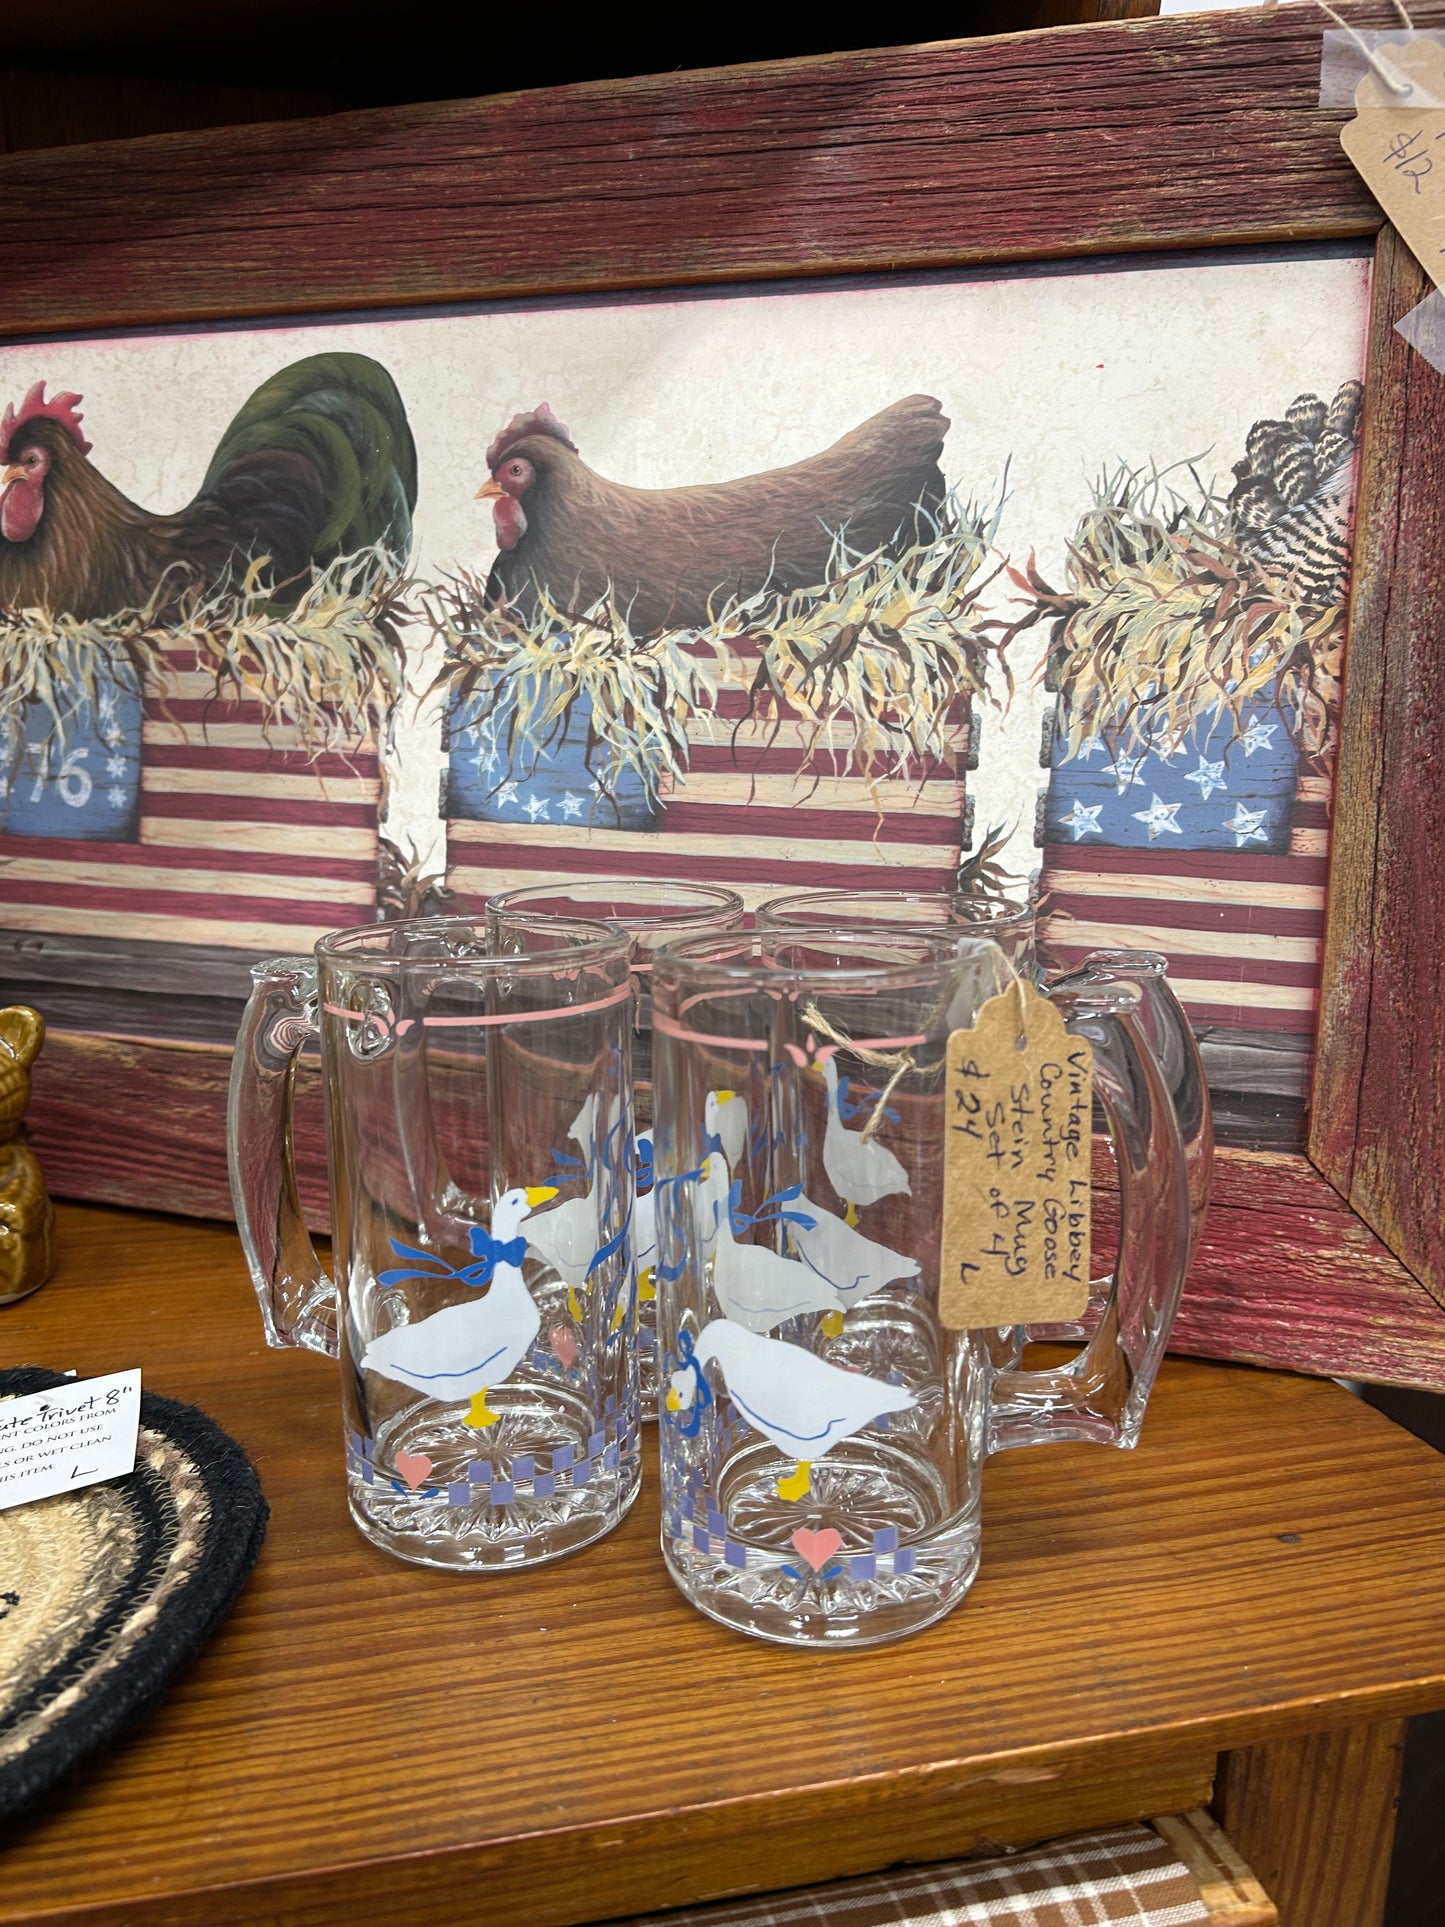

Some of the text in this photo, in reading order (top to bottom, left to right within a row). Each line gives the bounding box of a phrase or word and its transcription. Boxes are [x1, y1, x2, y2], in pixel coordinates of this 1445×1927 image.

[1383, 130, 1433, 194] $12
[25, 742, 93, 808] 76
[980, 1102, 1008, 1256] Set of 4
[1005, 1083, 1035, 1276] Stein Mug
[1037, 1063, 1065, 1280] Country Goose
[1060, 1052, 1087, 1282] Vintage Libbey
[24, 1408, 116, 1434] COLORS FROM
[37, 1396, 102, 1423] Trivet
[106, 1386, 132, 1405] 8"
[14, 1455, 35, 1465] OR
[37, 1447, 65, 1458] WET
[69, 1435, 112, 1450] CLEAN
[21, 1439, 43, 1450] DO
[46, 1431, 77, 1443] NOT
[80, 1424, 104, 1434] USE
[20, 1464, 55, 1477] ITEM.
